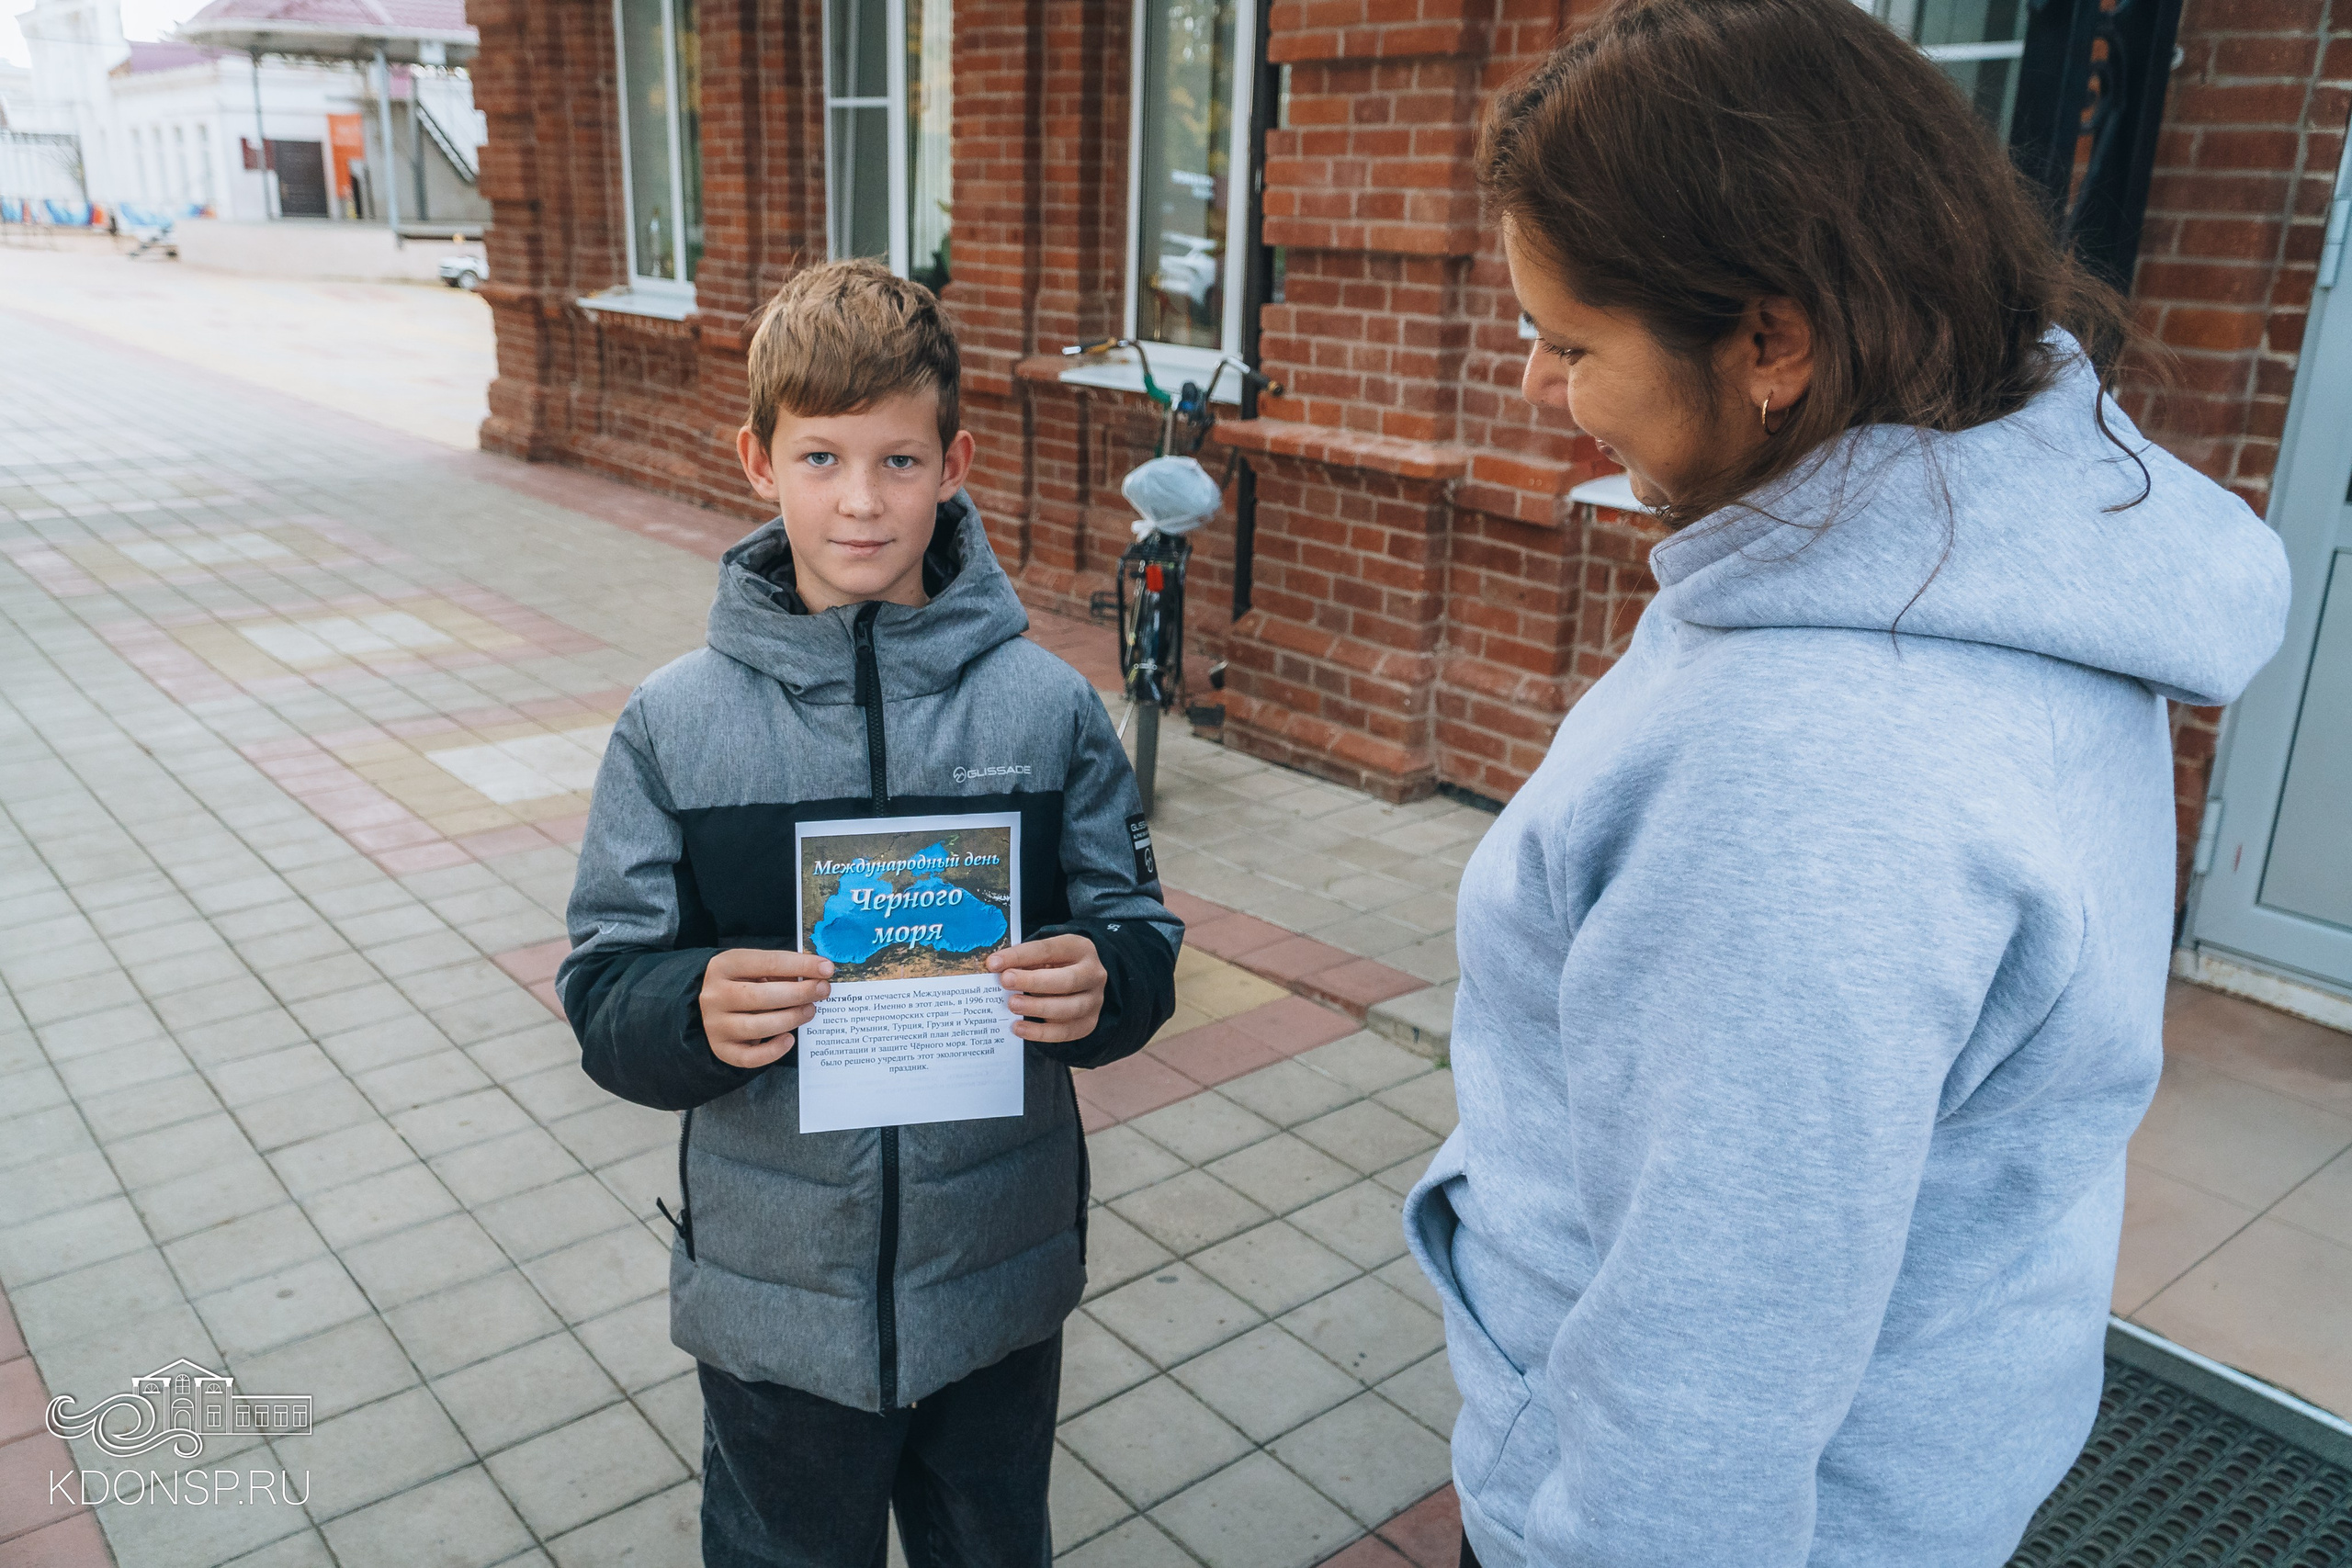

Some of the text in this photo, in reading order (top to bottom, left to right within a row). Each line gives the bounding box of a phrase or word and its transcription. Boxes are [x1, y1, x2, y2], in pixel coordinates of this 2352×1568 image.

[967, 765, 1032, 780] GLISSADE
[813, 852, 1001, 878] Международный день
[850, 887, 964, 919] Черного
[872, 922, 944, 950] моря
[826, 995, 863, 1003] октября
[865, 992, 910, 1000] отмечается
[913, 986, 981, 998] Международный
[816, 1006, 846, 1014] ёрного
[851, 1013, 924, 1023] причерноморских
[851, 1026, 889, 1034] Румыния,
[927, 1021, 954, 1029] Грузия
[964, 1018, 997, 1026] Украина
[816, 1036, 859, 1045] подписали
[862, 1032, 928, 1043] Стратегический
[952, 1028, 988, 1037] действий
[810, 1048, 868, 1058] реабилитации
[910, 1041, 944, 1051] Чёрного
[820, 1058, 842, 1066] было
[844, 1057, 876, 1066] решено
[877, 1055, 915, 1064] учредить
[936, 1047, 995, 1059] экологический
[889, 1064, 929, 1073] праздник.
